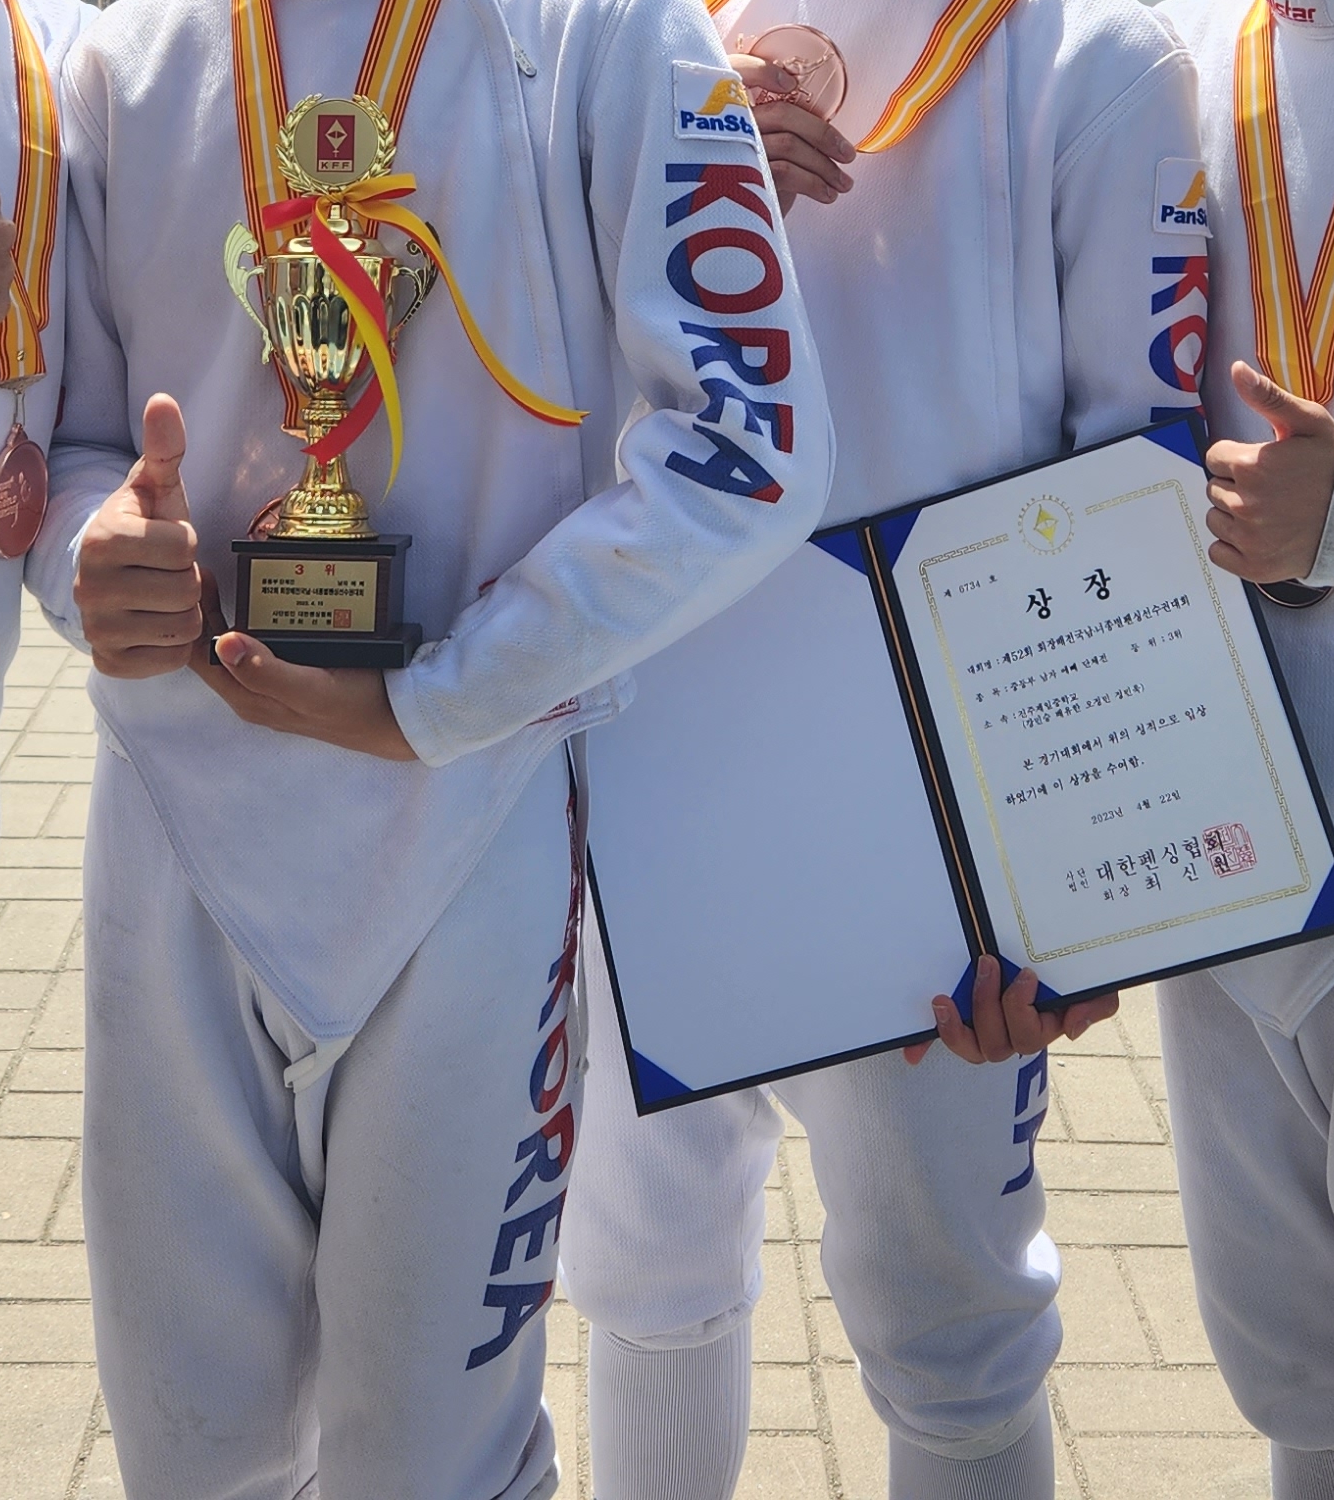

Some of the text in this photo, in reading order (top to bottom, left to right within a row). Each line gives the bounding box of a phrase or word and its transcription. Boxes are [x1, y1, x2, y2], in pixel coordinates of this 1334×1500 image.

[320, 161, 350, 170] KFF
[665, 163, 793, 504] KOREA
[295, 564, 304, 575] 3
[958, 580, 981, 594] 6734
[1038, 736, 1104, 767] 경기대회에서
[1108, 727, 1131, 745] 위의
[1069, 766, 1103, 787] 상장을
[1090, 806, 1125, 826] 2023년
[1096, 830, 1225, 883] 대한펜싱협회
